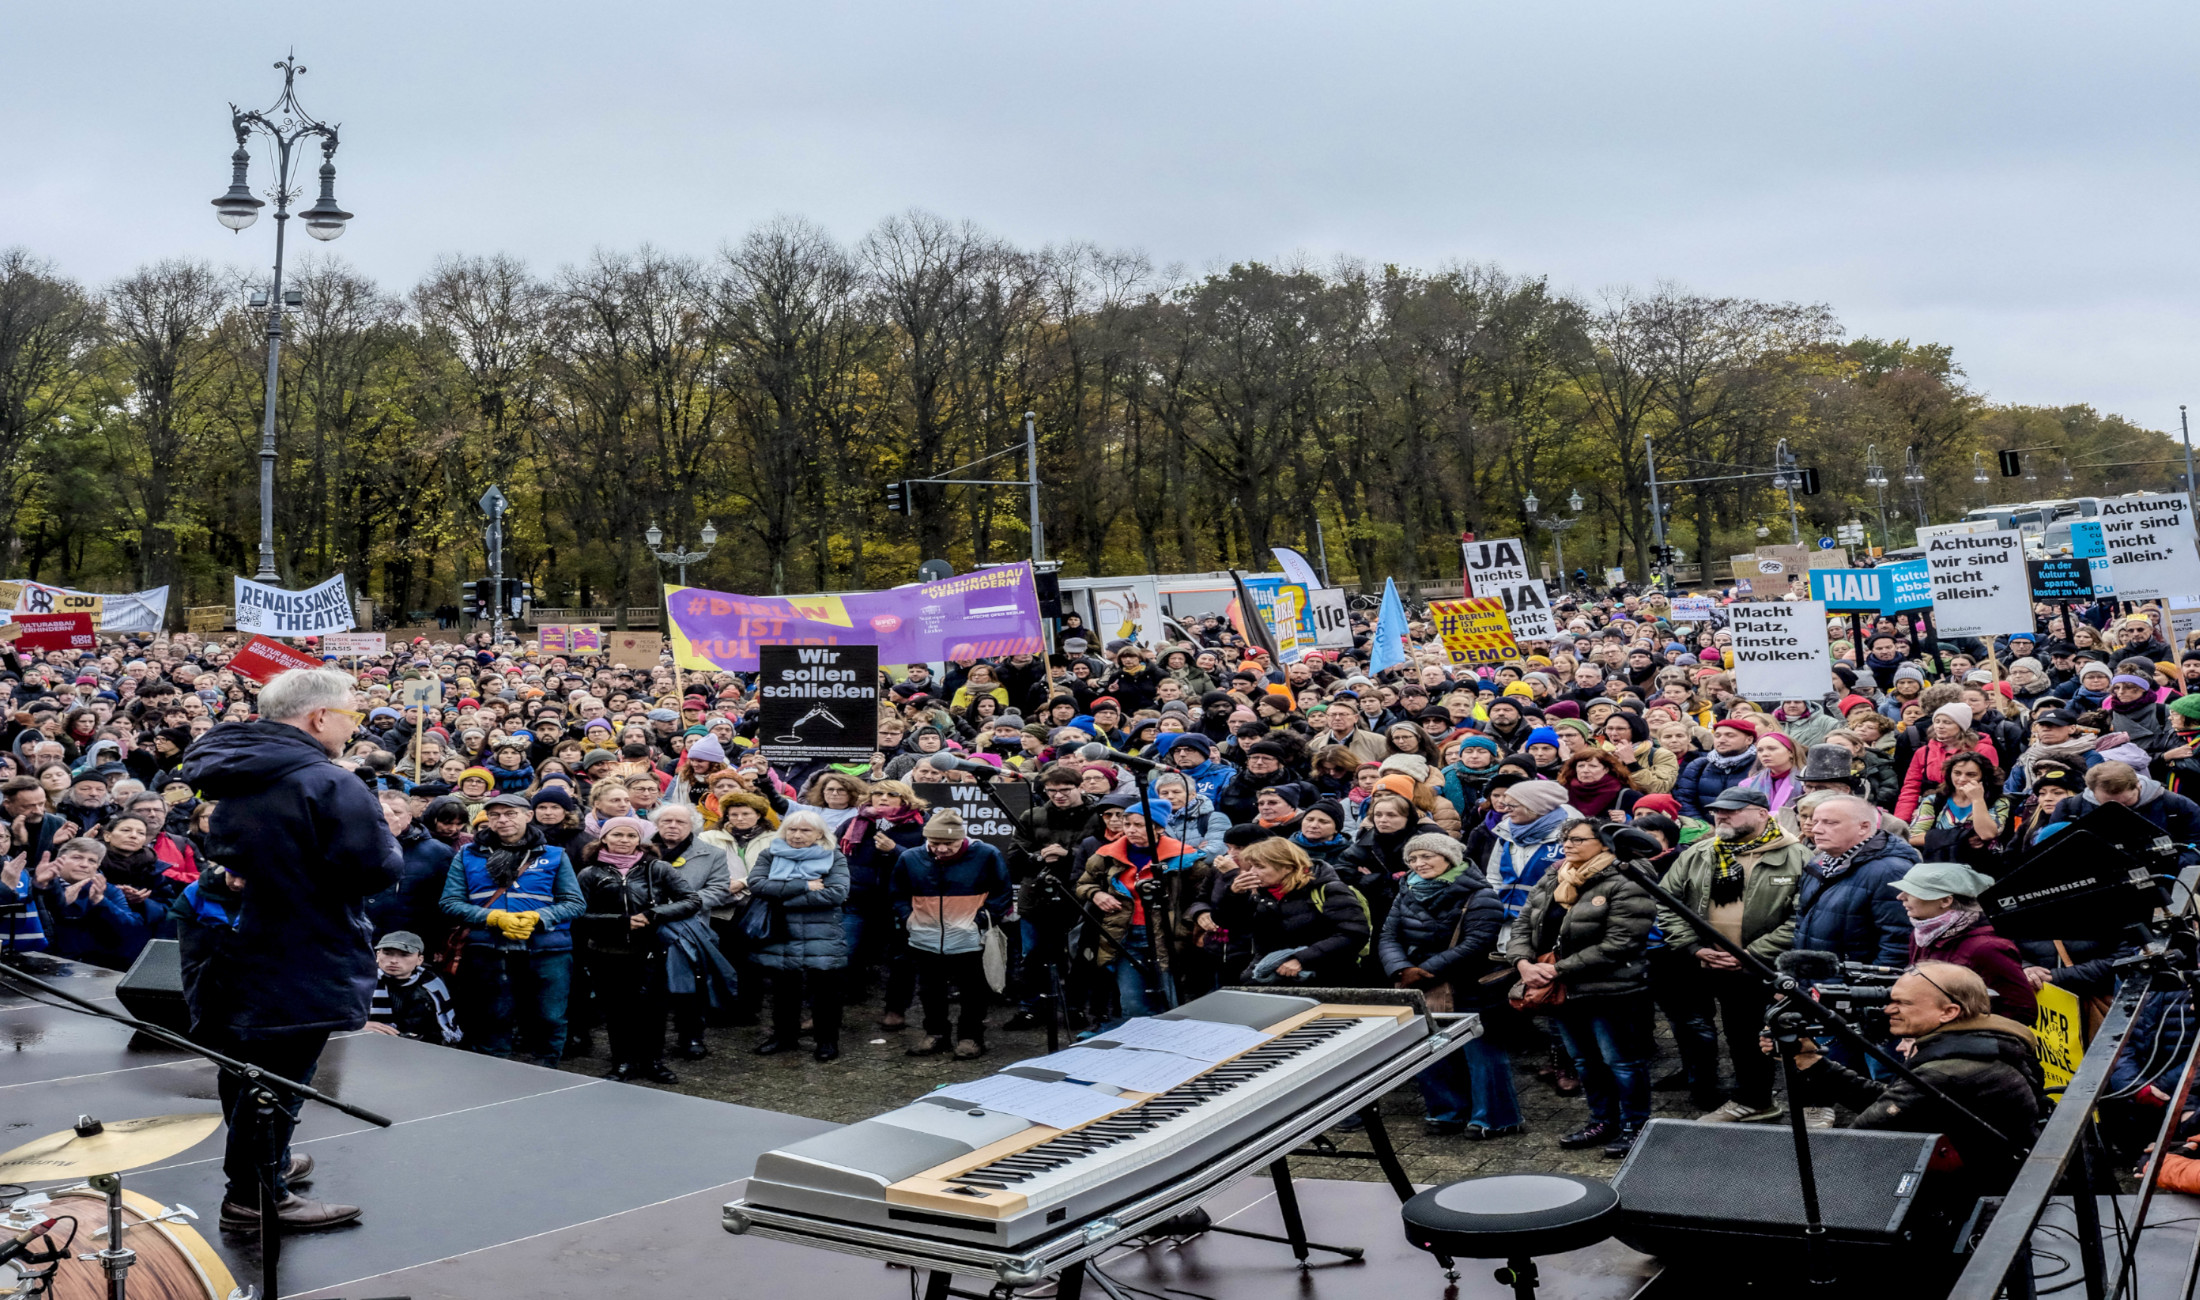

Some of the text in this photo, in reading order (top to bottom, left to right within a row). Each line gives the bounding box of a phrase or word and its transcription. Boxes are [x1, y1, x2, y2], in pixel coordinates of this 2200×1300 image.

[2102, 499, 2188, 516] Achtung,
[2081, 524, 2101, 532] Sav
[2105, 514, 2180, 532] wir sind
[1930, 536, 2018, 552] Achtung,
[2108, 534, 2157, 549] nicht
[1470, 542, 1521, 570] JA
[1931, 551, 2009, 568] wir sind
[2043, 562, 2056, 570] An
[2089, 559, 2109, 570] #B
[921, 568, 1023, 596] #KULTURABBAU
[1474, 569, 1523, 583] nichts
[1892, 571, 1929, 583] Kultu
[1934, 570, 1983, 584] nicht
[2038, 571, 2066, 579] Kultur
[929, 577, 1021, 599] VERHINDERN!
[1823, 573, 1881, 601] HAU
[1896, 582, 1931, 592] abba
[2044, 580, 2078, 588] sparen,
[2094, 584, 2114, 594] Cu
[1894, 591, 1933, 603] rhind
[2033, 588, 2060, 596] kostet
[63, 597, 95, 608] CDU
[686, 596, 830, 620] #BERLIN
[1458, 612, 1496, 621] BERLIN
[1508, 612, 1548, 626] ichts
[1733, 606, 1793, 618] Macht
[738, 617, 788, 637] IST
[1440, 615, 1458, 635] #
[1462, 625, 1504, 634] KULTUR
[1512, 625, 1547, 638] st ok
[1735, 622, 1788, 633] Platz,
[1735, 636, 1798, 647] finstre
[798, 649, 840, 664] Wir
[1451, 647, 1518, 662] DEMO
[782, 666, 856, 682] sollen
[763, 683, 875, 699] schließen
[2018, 877, 2097, 902] SENNHEISER
